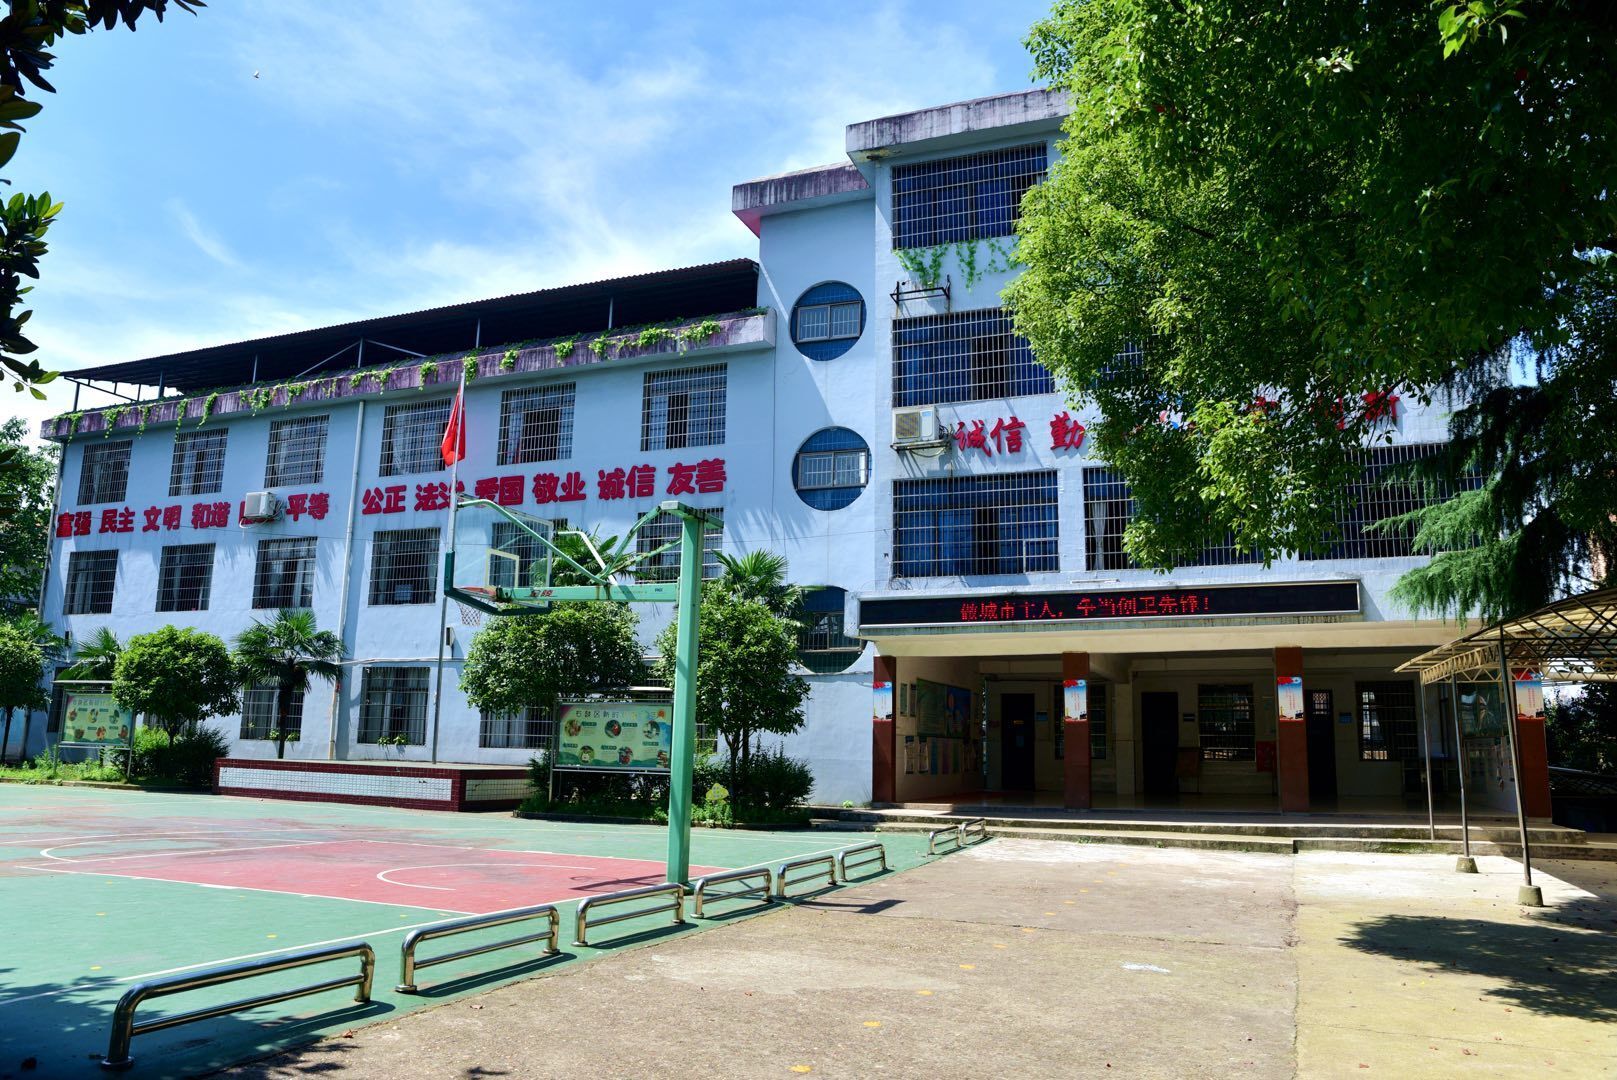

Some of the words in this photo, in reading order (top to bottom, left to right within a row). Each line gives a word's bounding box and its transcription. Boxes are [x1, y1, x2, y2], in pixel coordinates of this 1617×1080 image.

[954, 415, 1026, 457] 诚信
[361, 486, 406, 515] 公正
[532, 472, 587, 504] 敬业
[597, 465, 656, 501] 诚信
[666, 458, 727, 495] 友善
[56, 512, 92, 538] 富强
[99, 506, 136, 534] 民主
[142, 505, 181, 532] 文明
[191, 502, 231, 529] 和谐
[286, 493, 329, 522] 平等
